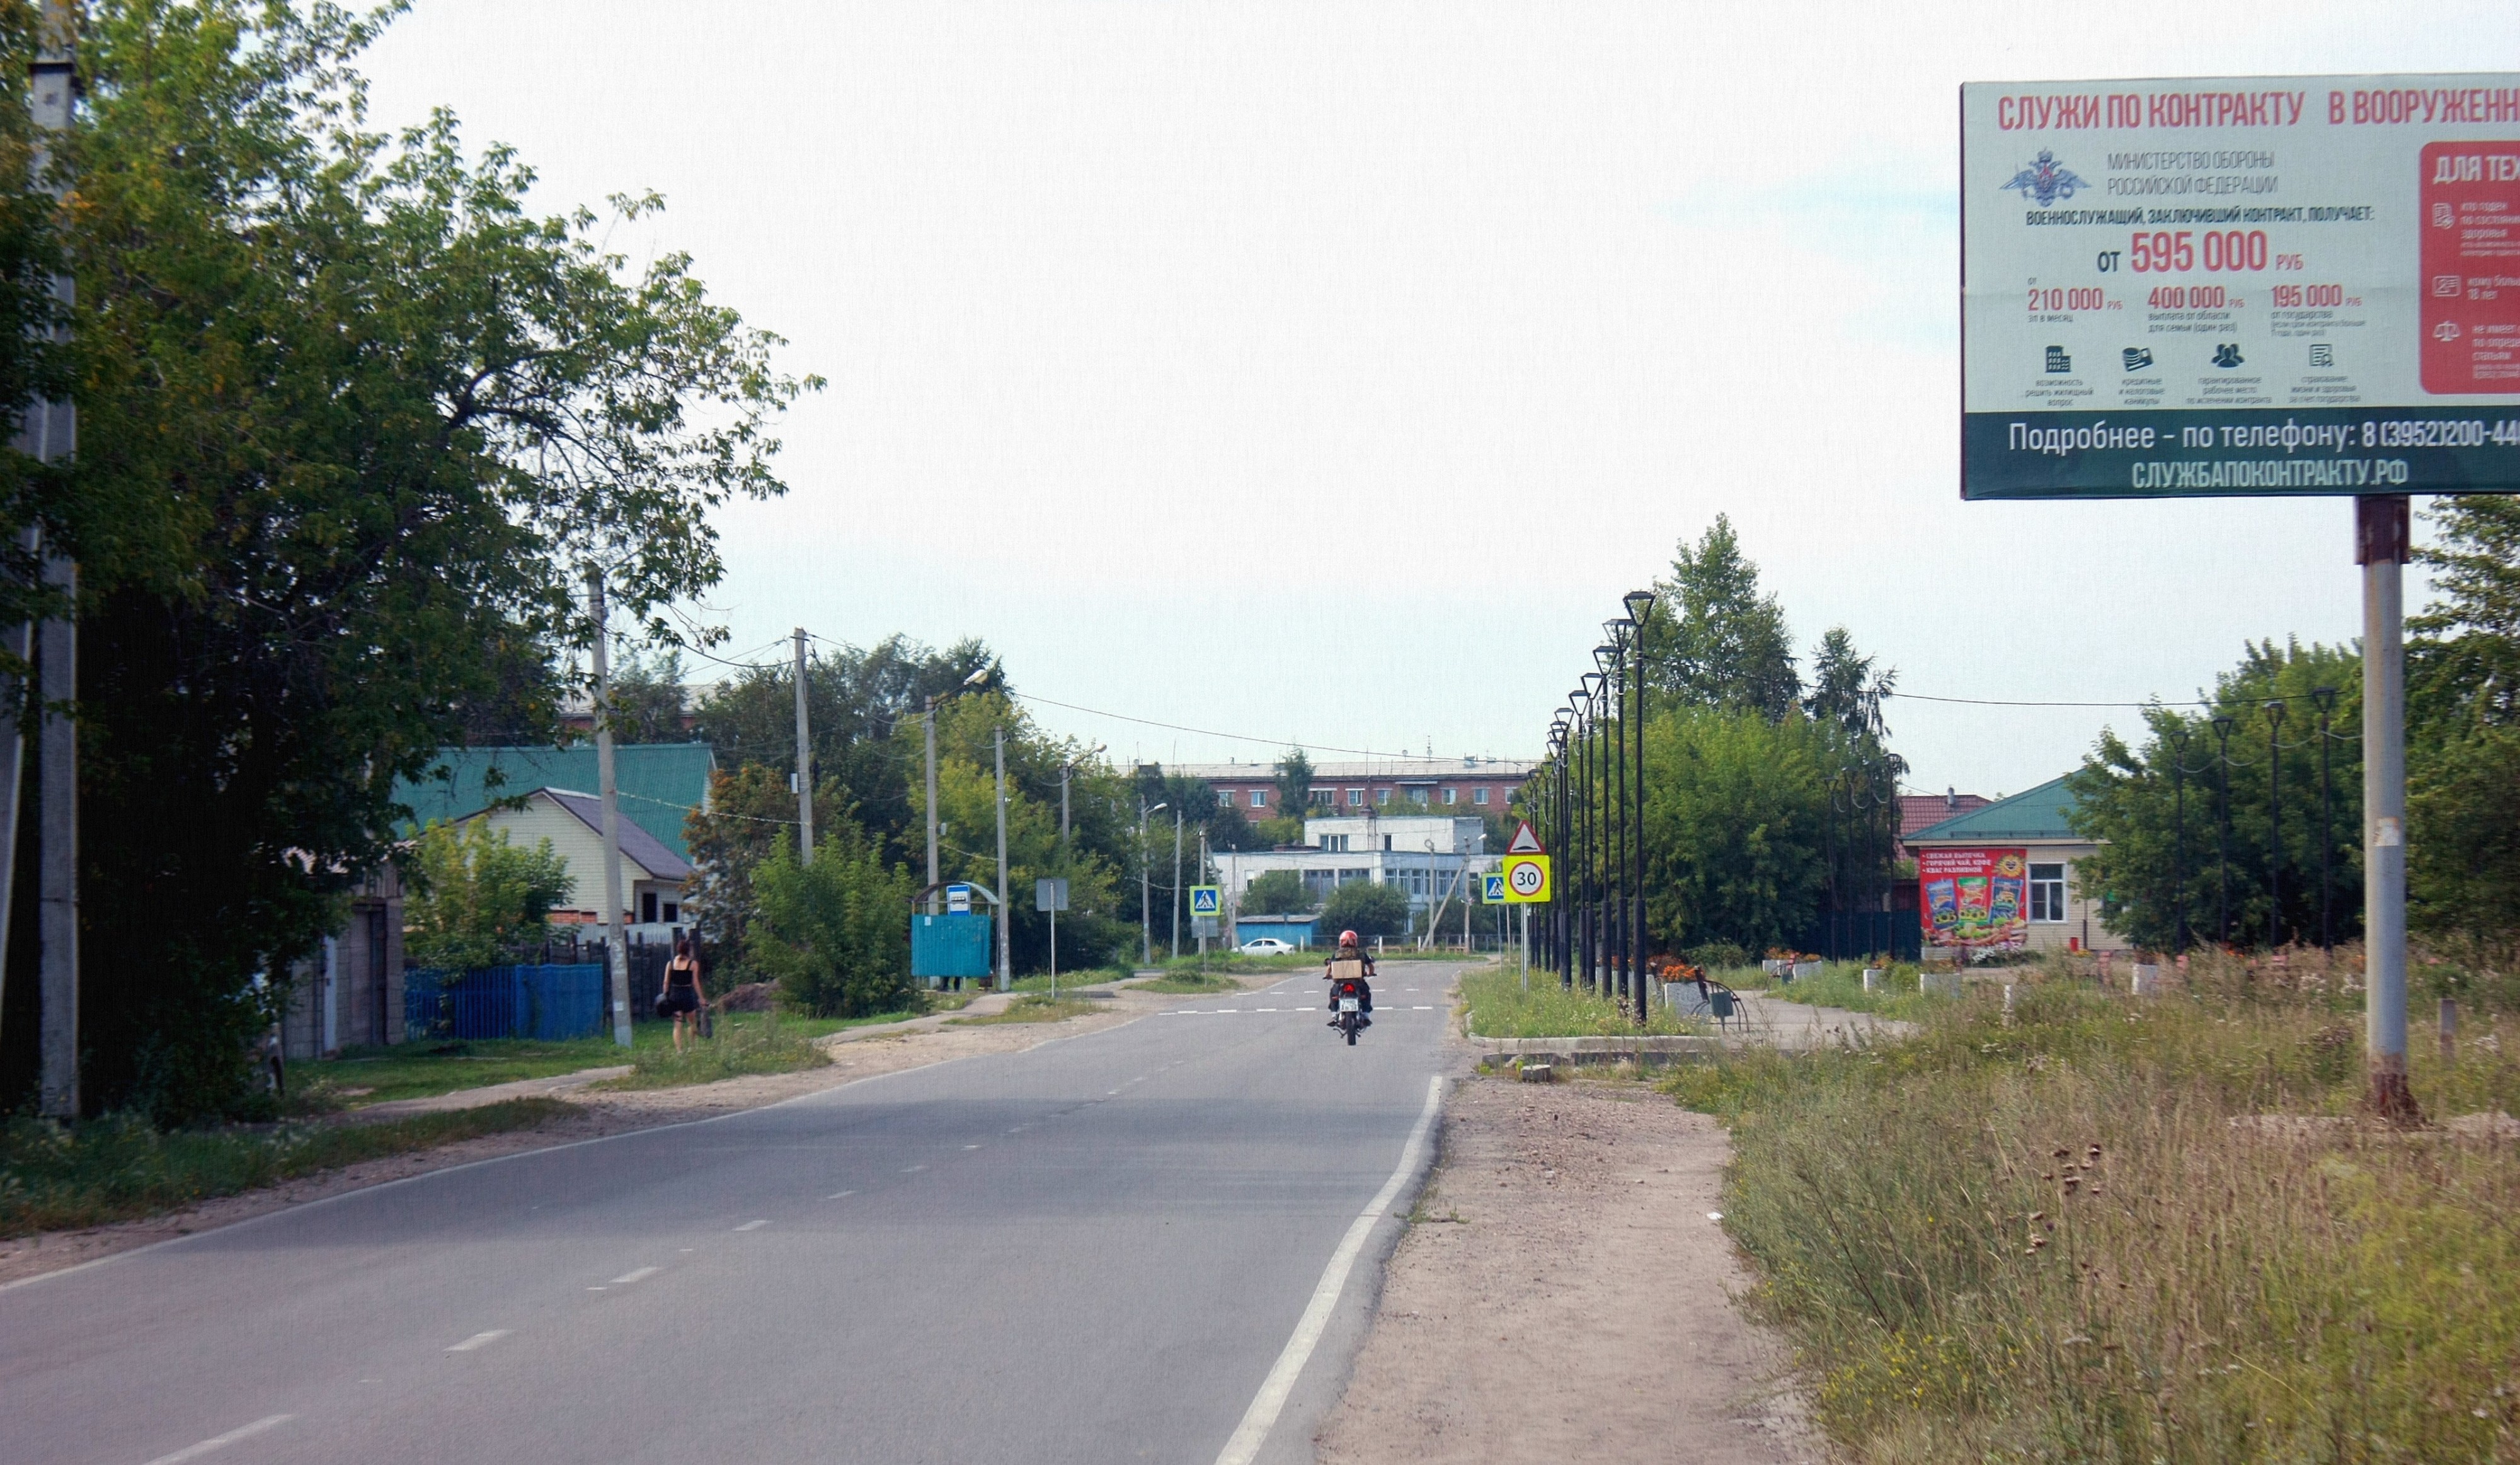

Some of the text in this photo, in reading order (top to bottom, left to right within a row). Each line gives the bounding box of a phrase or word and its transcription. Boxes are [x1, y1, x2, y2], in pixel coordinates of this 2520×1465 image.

[1998, 88, 2520, 130] СЛУЖИ ПО КОНТРАКТУ В ВООРУЖЕНН
[2107, 151, 2275, 171] МИНИСТЕРСТВО ОБОРОНЫ
[2433, 155, 2483, 185] ДЛЯ
[2107, 174, 2279, 196] РОССИЙСКОЙ ФЕДЕРАЦИИ
[2025, 205, 2374, 226] ВОЕННОСЛУЖАЩИЙ, ЗАКЛЮЧИВШИЙ КОНТРАКТ, ПОЛУЧАЕТ:
[2097, 230, 2304, 273] ОТ 595 000 РУБ
[2027, 287, 2124, 311] 210 000 РУБ
[2147, 286, 2245, 309] 400 000 РУБ
[2271, 285, 2303, 308] 195
[2306, 284, 2343, 307] 000
[2009, 420, 2155, 456] Подробнее
[2182, 426, 2214, 448] по
[2220, 418, 2355, 453] телефону:
[2361, 421, 2376, 448] 8
[2380, 419, 2520, 447] (3952)200-44
[2131, 459, 2409, 489] СЛУЖБАПОКОНТРАКТУ.РФ
[1517, 872, 1537, 886] 30
